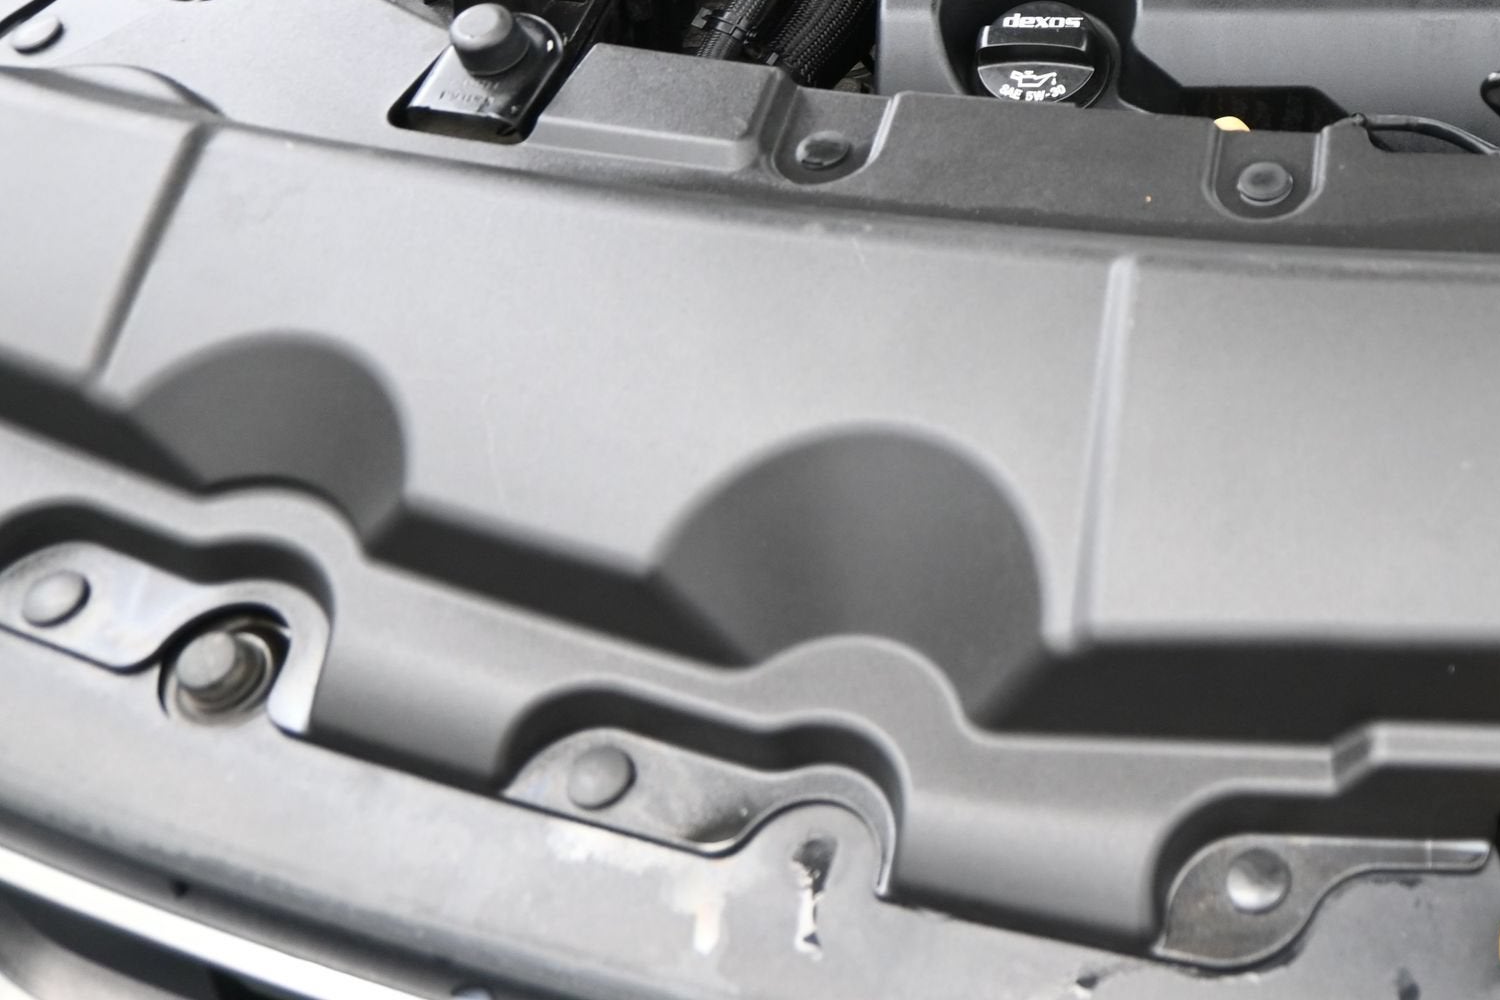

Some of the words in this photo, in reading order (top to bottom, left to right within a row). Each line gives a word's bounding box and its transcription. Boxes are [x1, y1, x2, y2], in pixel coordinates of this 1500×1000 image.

[1002, 12, 1084, 29] dexos
[999, 83, 1023, 101] SAE
[1025, 83, 1067, 102] 5W-30
